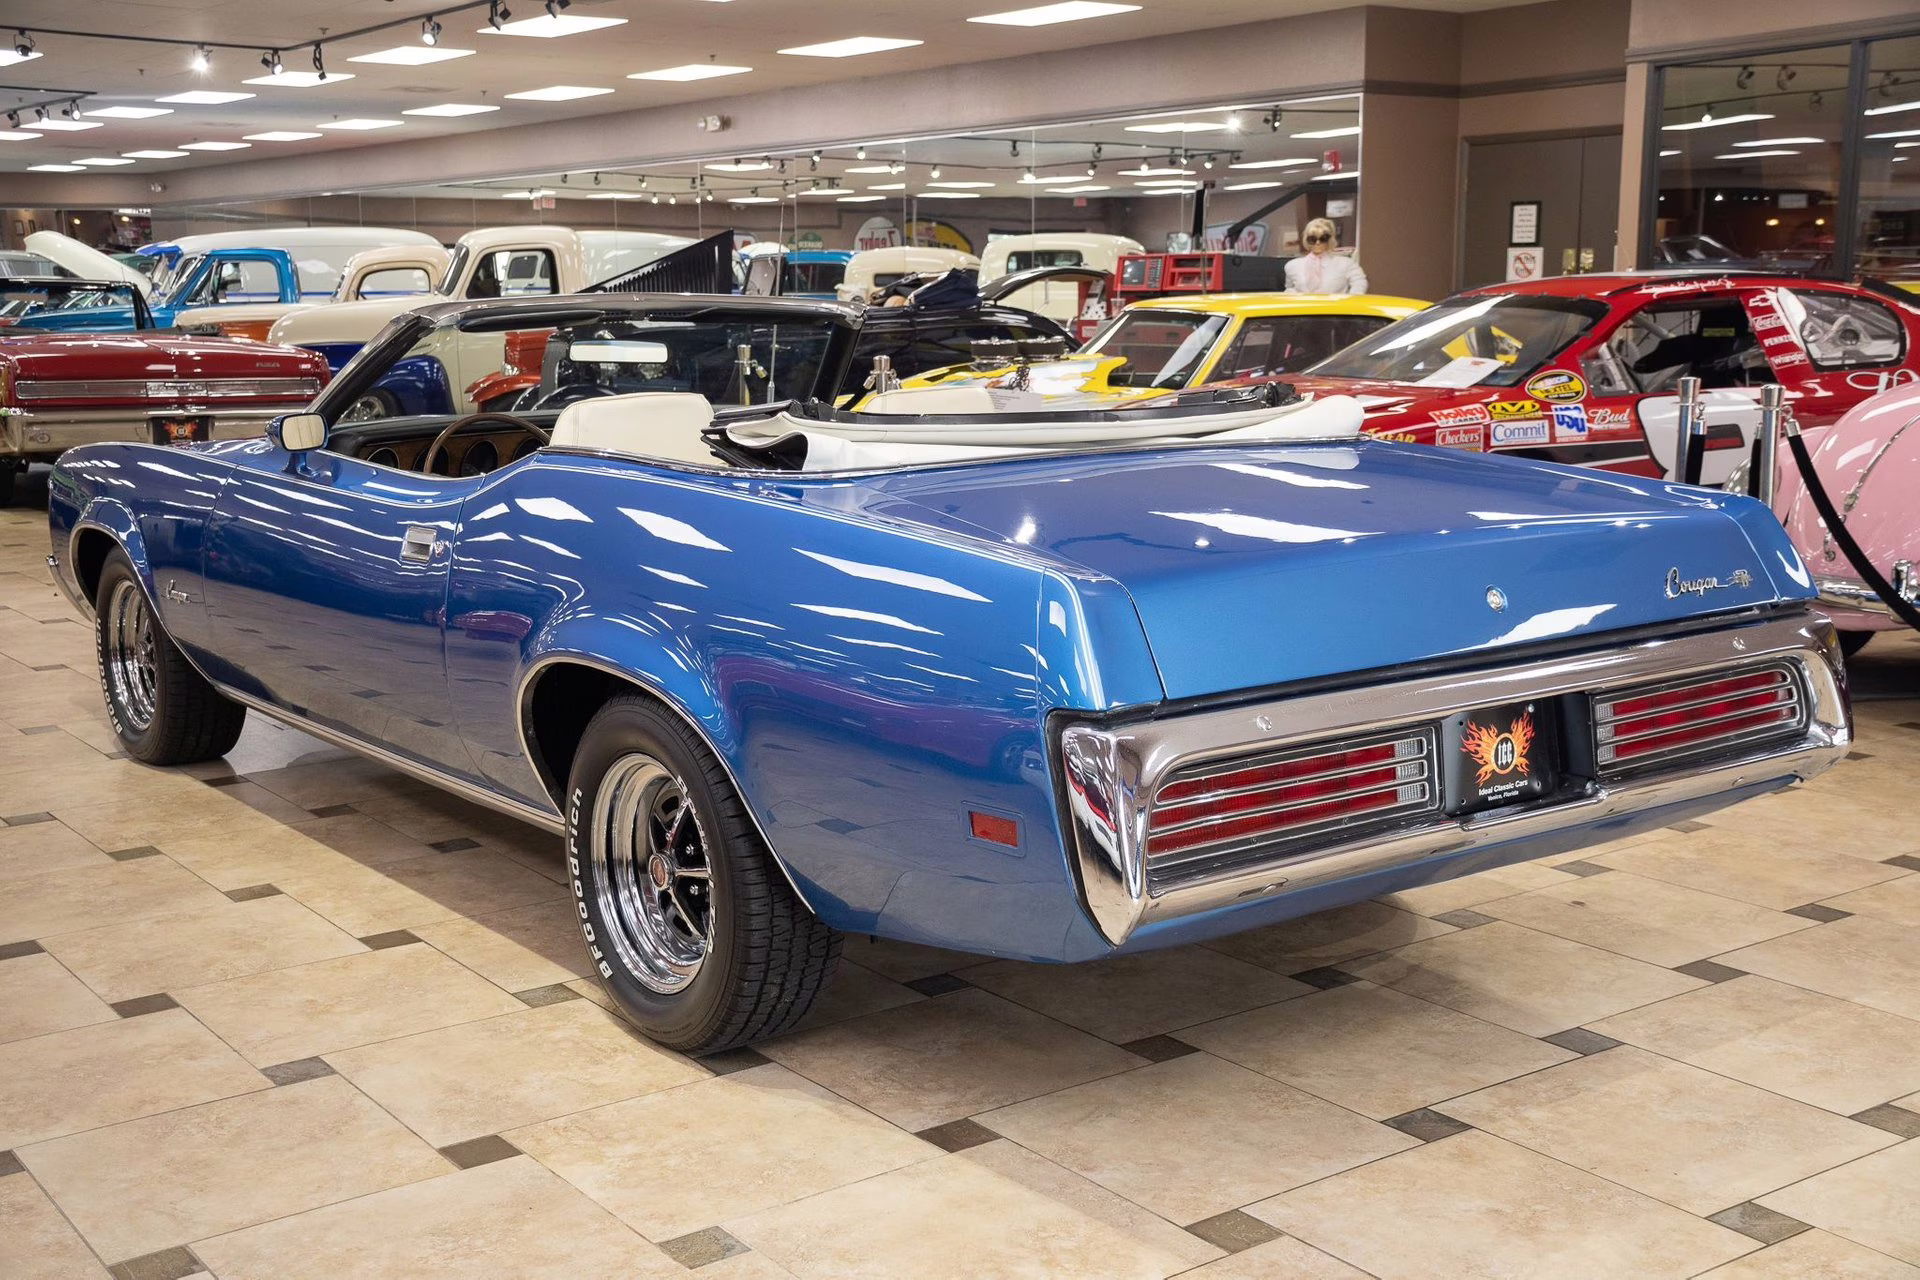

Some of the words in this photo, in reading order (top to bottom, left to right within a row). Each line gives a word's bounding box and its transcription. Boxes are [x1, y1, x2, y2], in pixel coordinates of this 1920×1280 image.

[1433, 405, 1487, 421] Holley
[1588, 408, 1630, 424] Bud
[1438, 429, 1480, 445] Checkers
[1493, 422, 1546, 442] Commit
[1664, 566, 1728, 600] Cougar
[1479, 786, 1493, 796] Ideal
[1494, 783, 1514, 792] Classic
[568, 787, 614, 980] BFGoodrich
